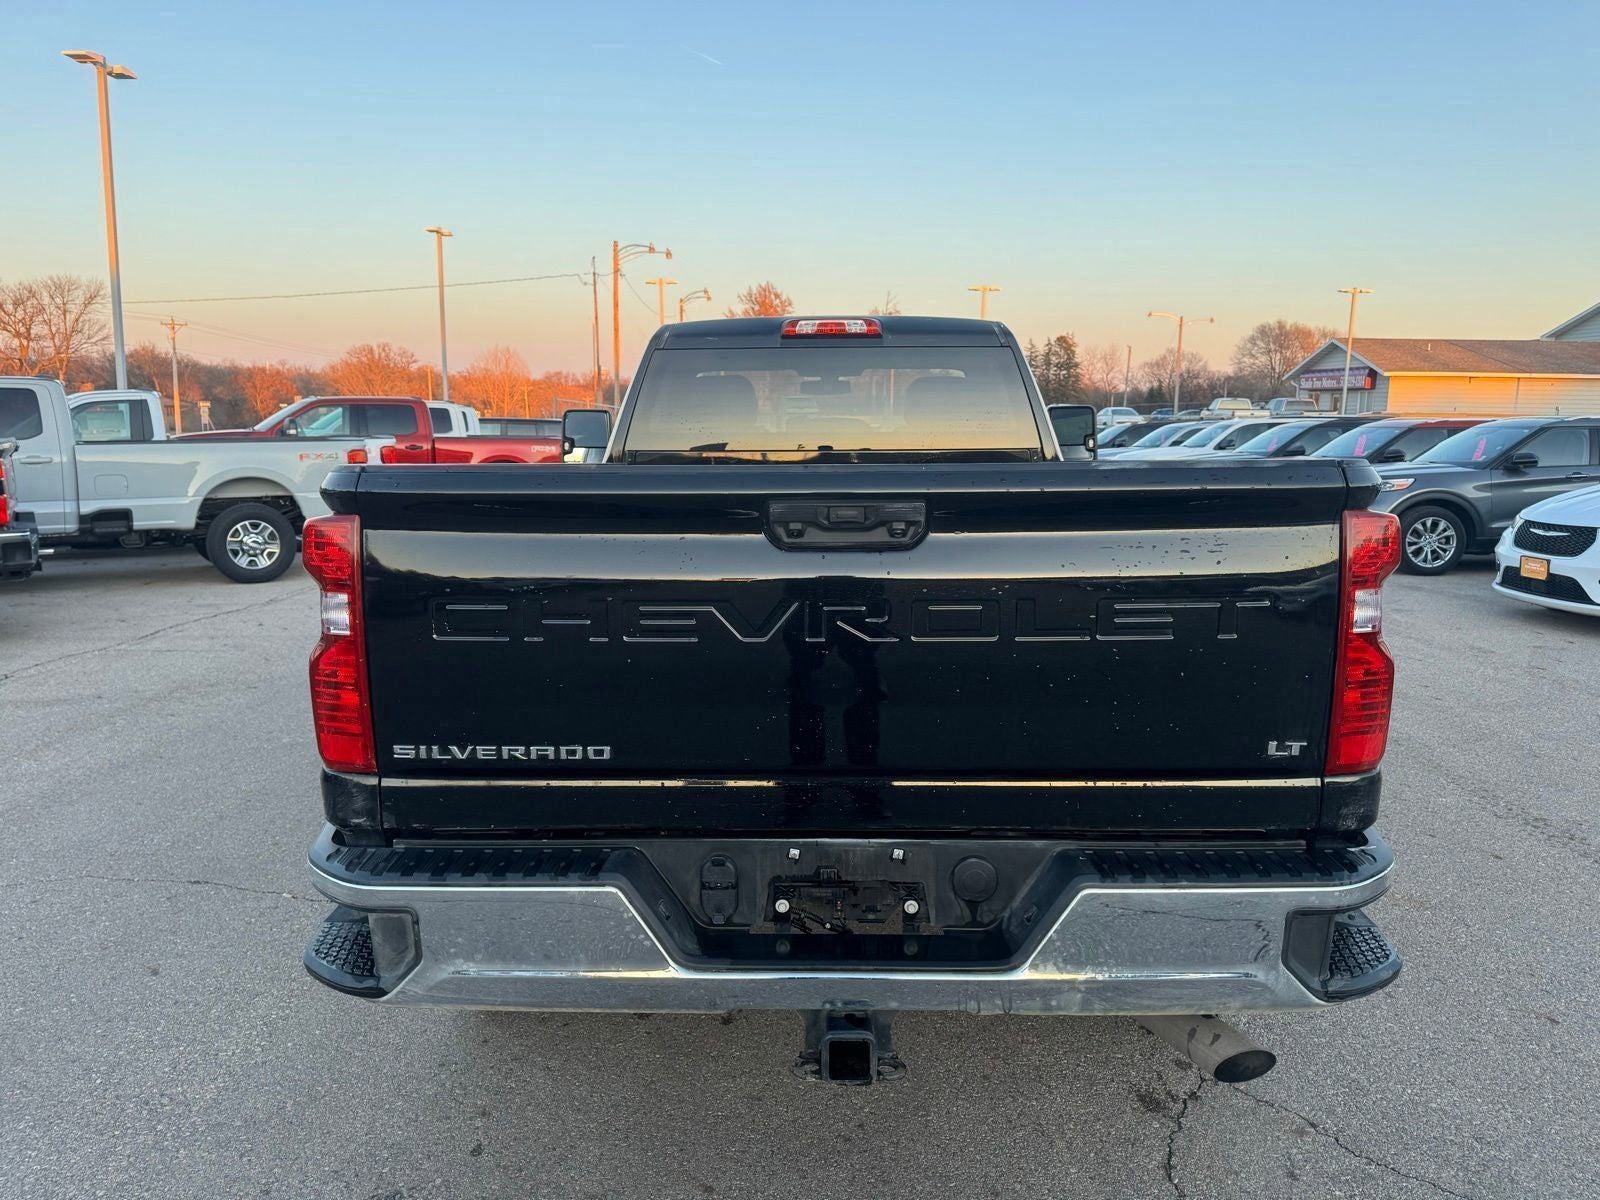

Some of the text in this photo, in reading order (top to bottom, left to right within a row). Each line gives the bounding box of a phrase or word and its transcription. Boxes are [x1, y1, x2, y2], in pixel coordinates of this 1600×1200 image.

[298, 452, 339, 462] FX4
[432, 599, 1272, 642] CHEVROLET
[393, 745, 611, 760] SILVERADO
[1267, 741, 1307, 756] LT
